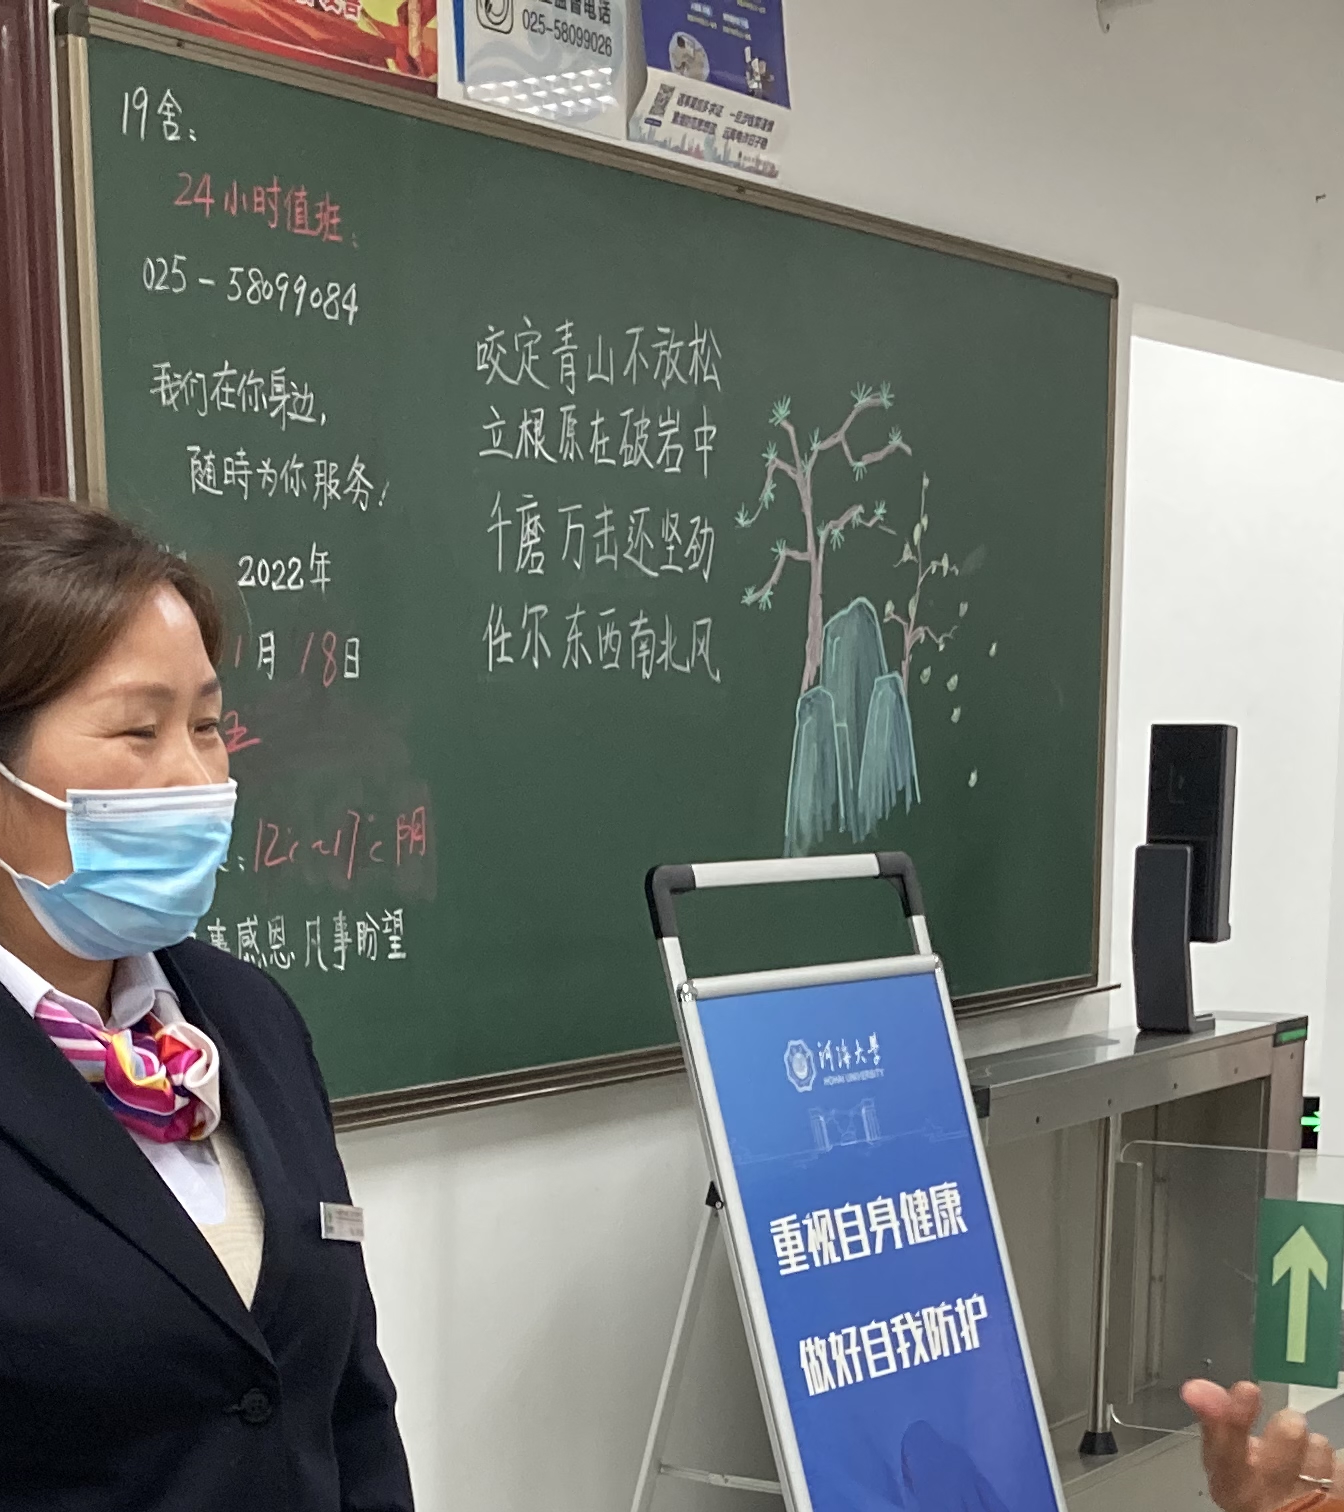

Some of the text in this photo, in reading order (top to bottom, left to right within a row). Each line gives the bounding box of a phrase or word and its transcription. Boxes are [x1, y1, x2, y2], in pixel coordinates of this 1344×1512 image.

[522, 8, 613, 57] 025-58099026
[476, 315, 722, 395] 咬定青山不放松
[478, 404, 717, 478] 立根原在破岩中
[237, 541, 332, 602] 2022年
[486, 491, 716, 583] 千磨万击还坚劲
[482, 601, 721, 684] 任尔东西南北风
[769, 1181, 968, 1276] 重视自身健康
[799, 1292, 988, 1397] 做好自我防护
